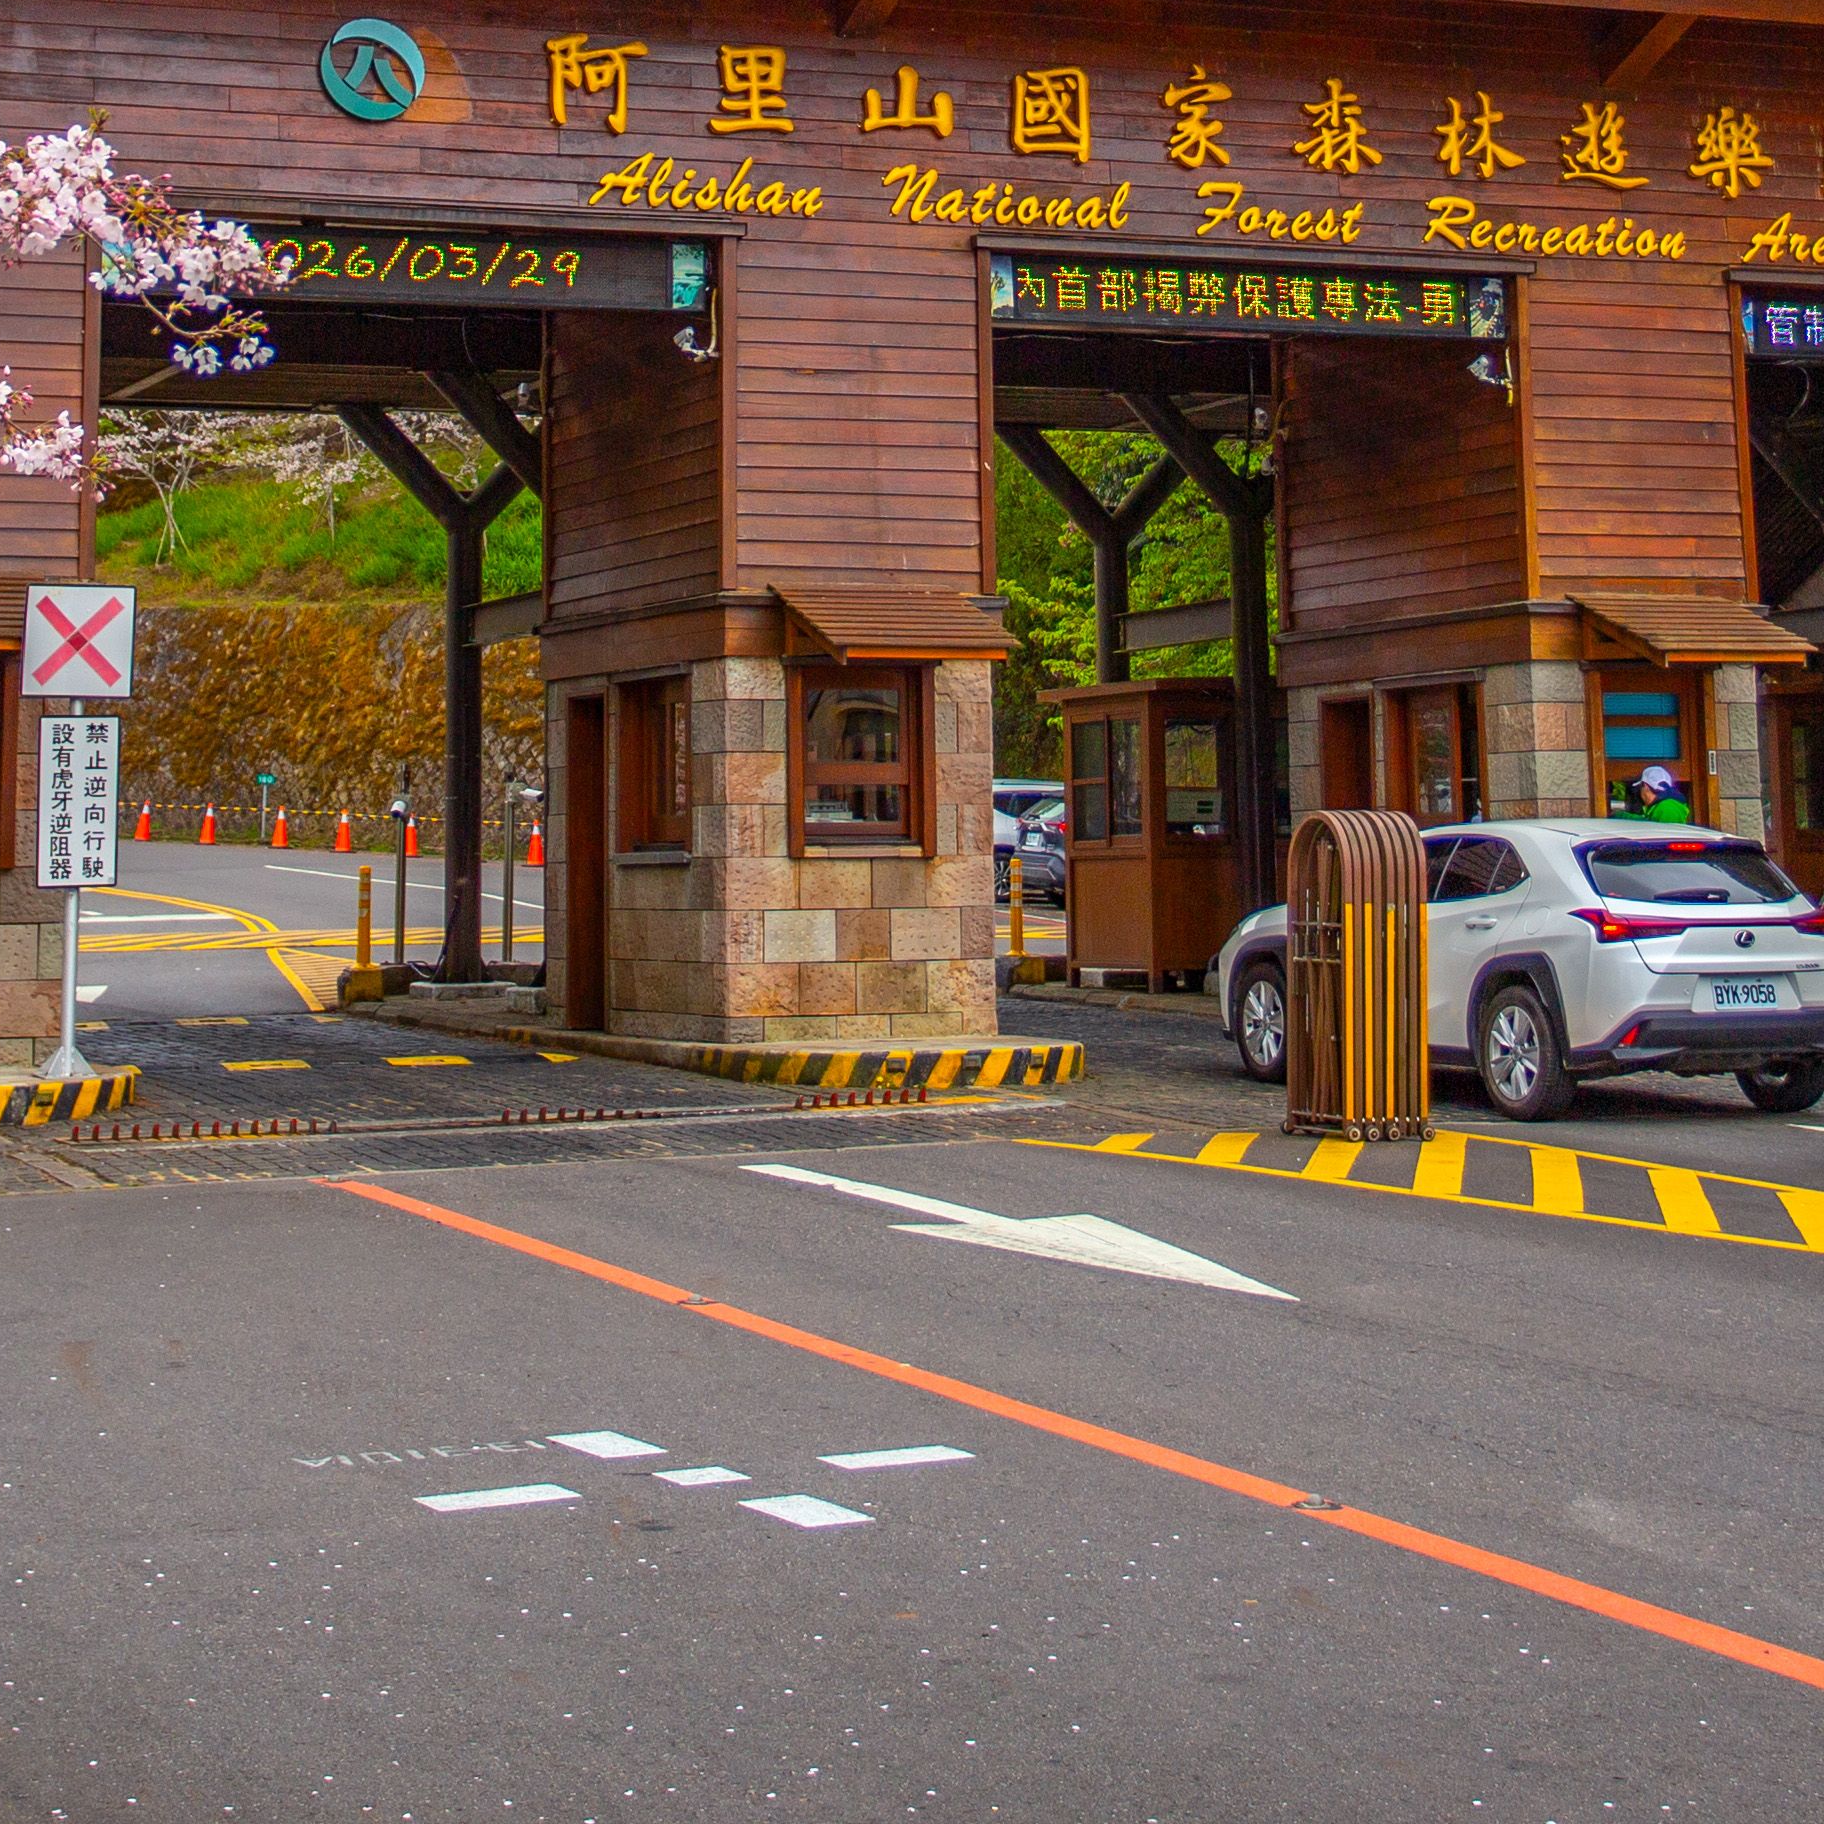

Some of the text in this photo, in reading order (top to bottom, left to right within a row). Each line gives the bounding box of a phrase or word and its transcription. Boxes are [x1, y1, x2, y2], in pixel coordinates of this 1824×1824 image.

[587, 152, 824, 218] Alishan
[881, 163, 1131, 230] National
[1196, 181, 1364, 244] Forest
[1423, 196, 1686, 260] Recreation
[246, 236, 581, 288] 026/03/29
[49, 723, 75, 880] 設有虎牙逆阻器
[82, 722, 108, 878] 禁止逆向行駛
[1714, 984, 1776, 1005] BYK-9058
